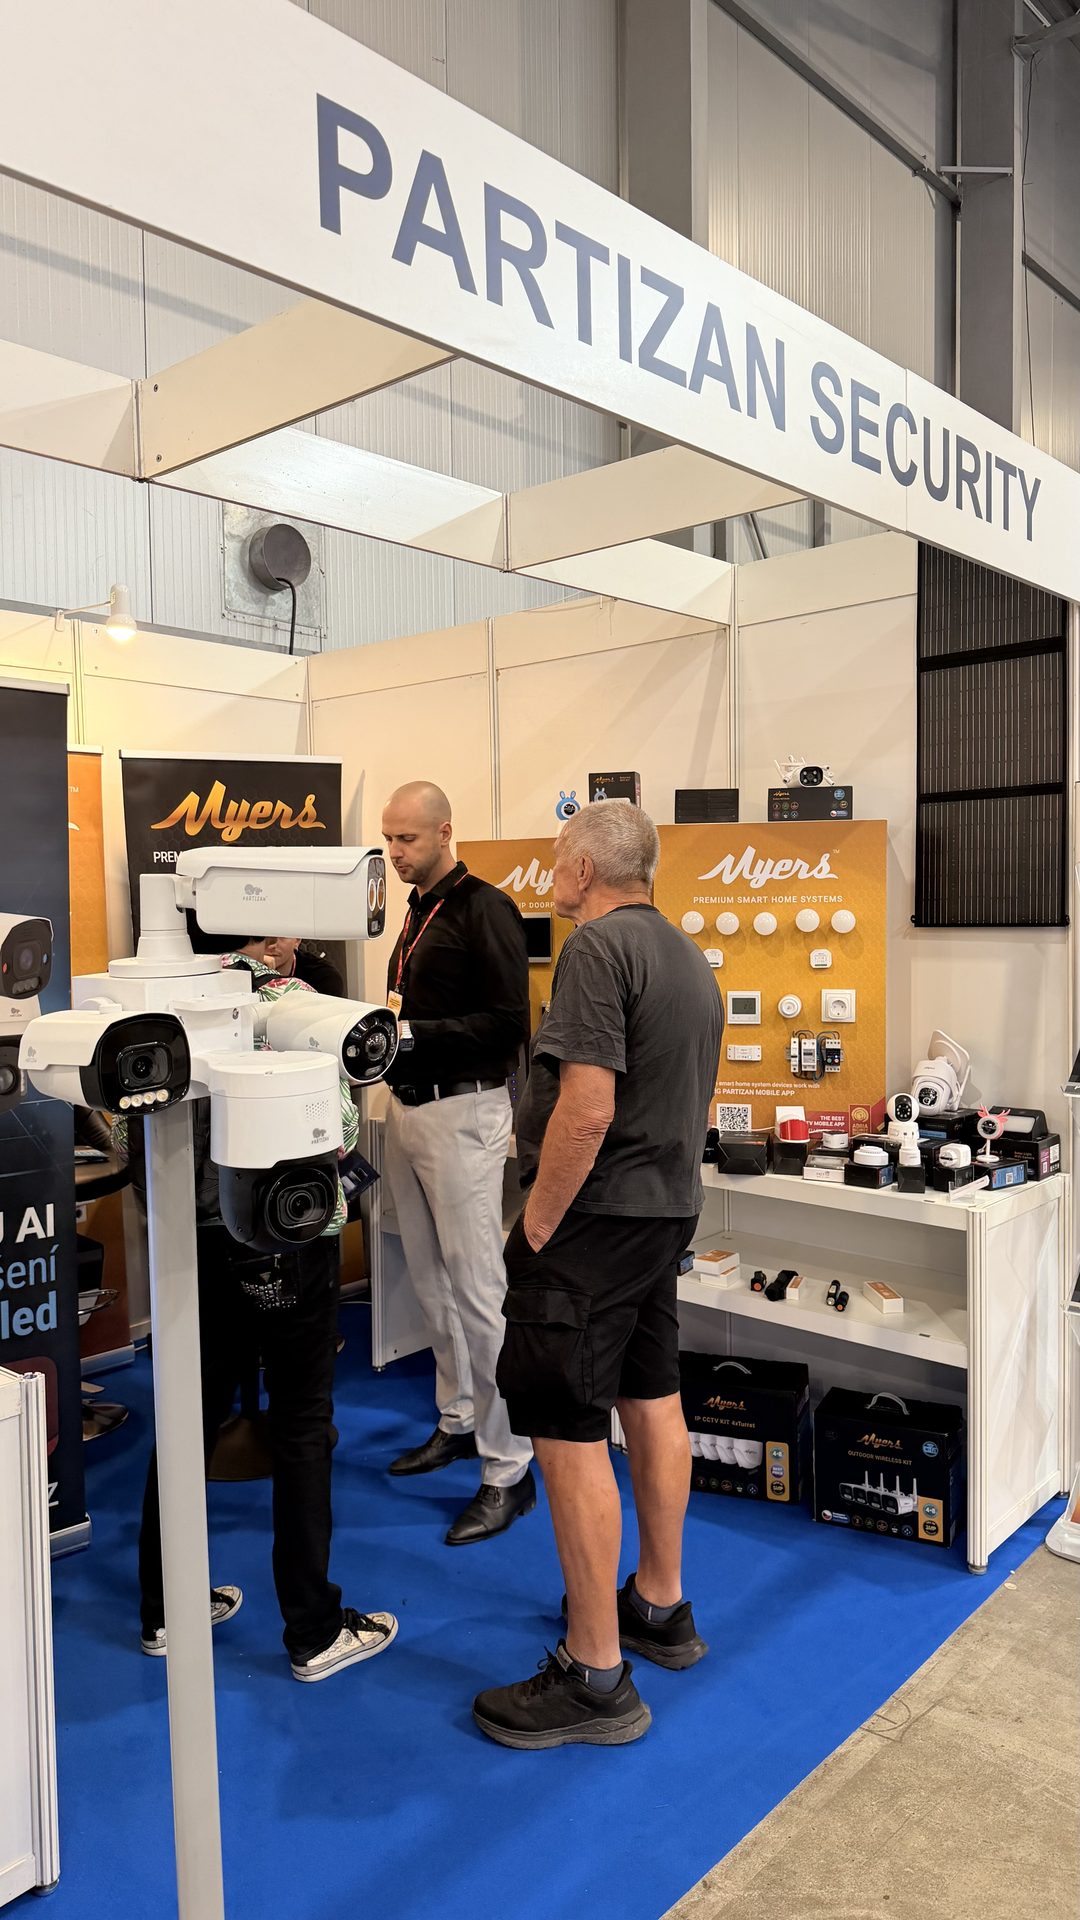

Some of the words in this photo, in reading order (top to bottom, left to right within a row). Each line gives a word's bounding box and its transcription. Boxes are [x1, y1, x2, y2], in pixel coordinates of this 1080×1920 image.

[316, 93, 785, 432] PARTIZAN
[809, 361, 1042, 542] SECURITY
[151, 780, 327, 842] Myers
[697, 845, 839, 889] Myers
[693, 896, 734, 904] PREMIUM
[737, 896, 768, 904] SMART
[800, 895, 844, 903] SYSTEMS
[722, 1088, 755, 1096] PARTIZAN
[15, 1203, 55, 1244] AI
[0, 1243, 60, 1291] ení
[703, 1395, 748, 1411] Myers
[702, 1416, 719, 1424] CCTV
[857, 1433, 904, 1450] Myers
[848, 1450, 875, 1459] OUTDOOR
[875, 1454, 902, 1465] WIRELESS
